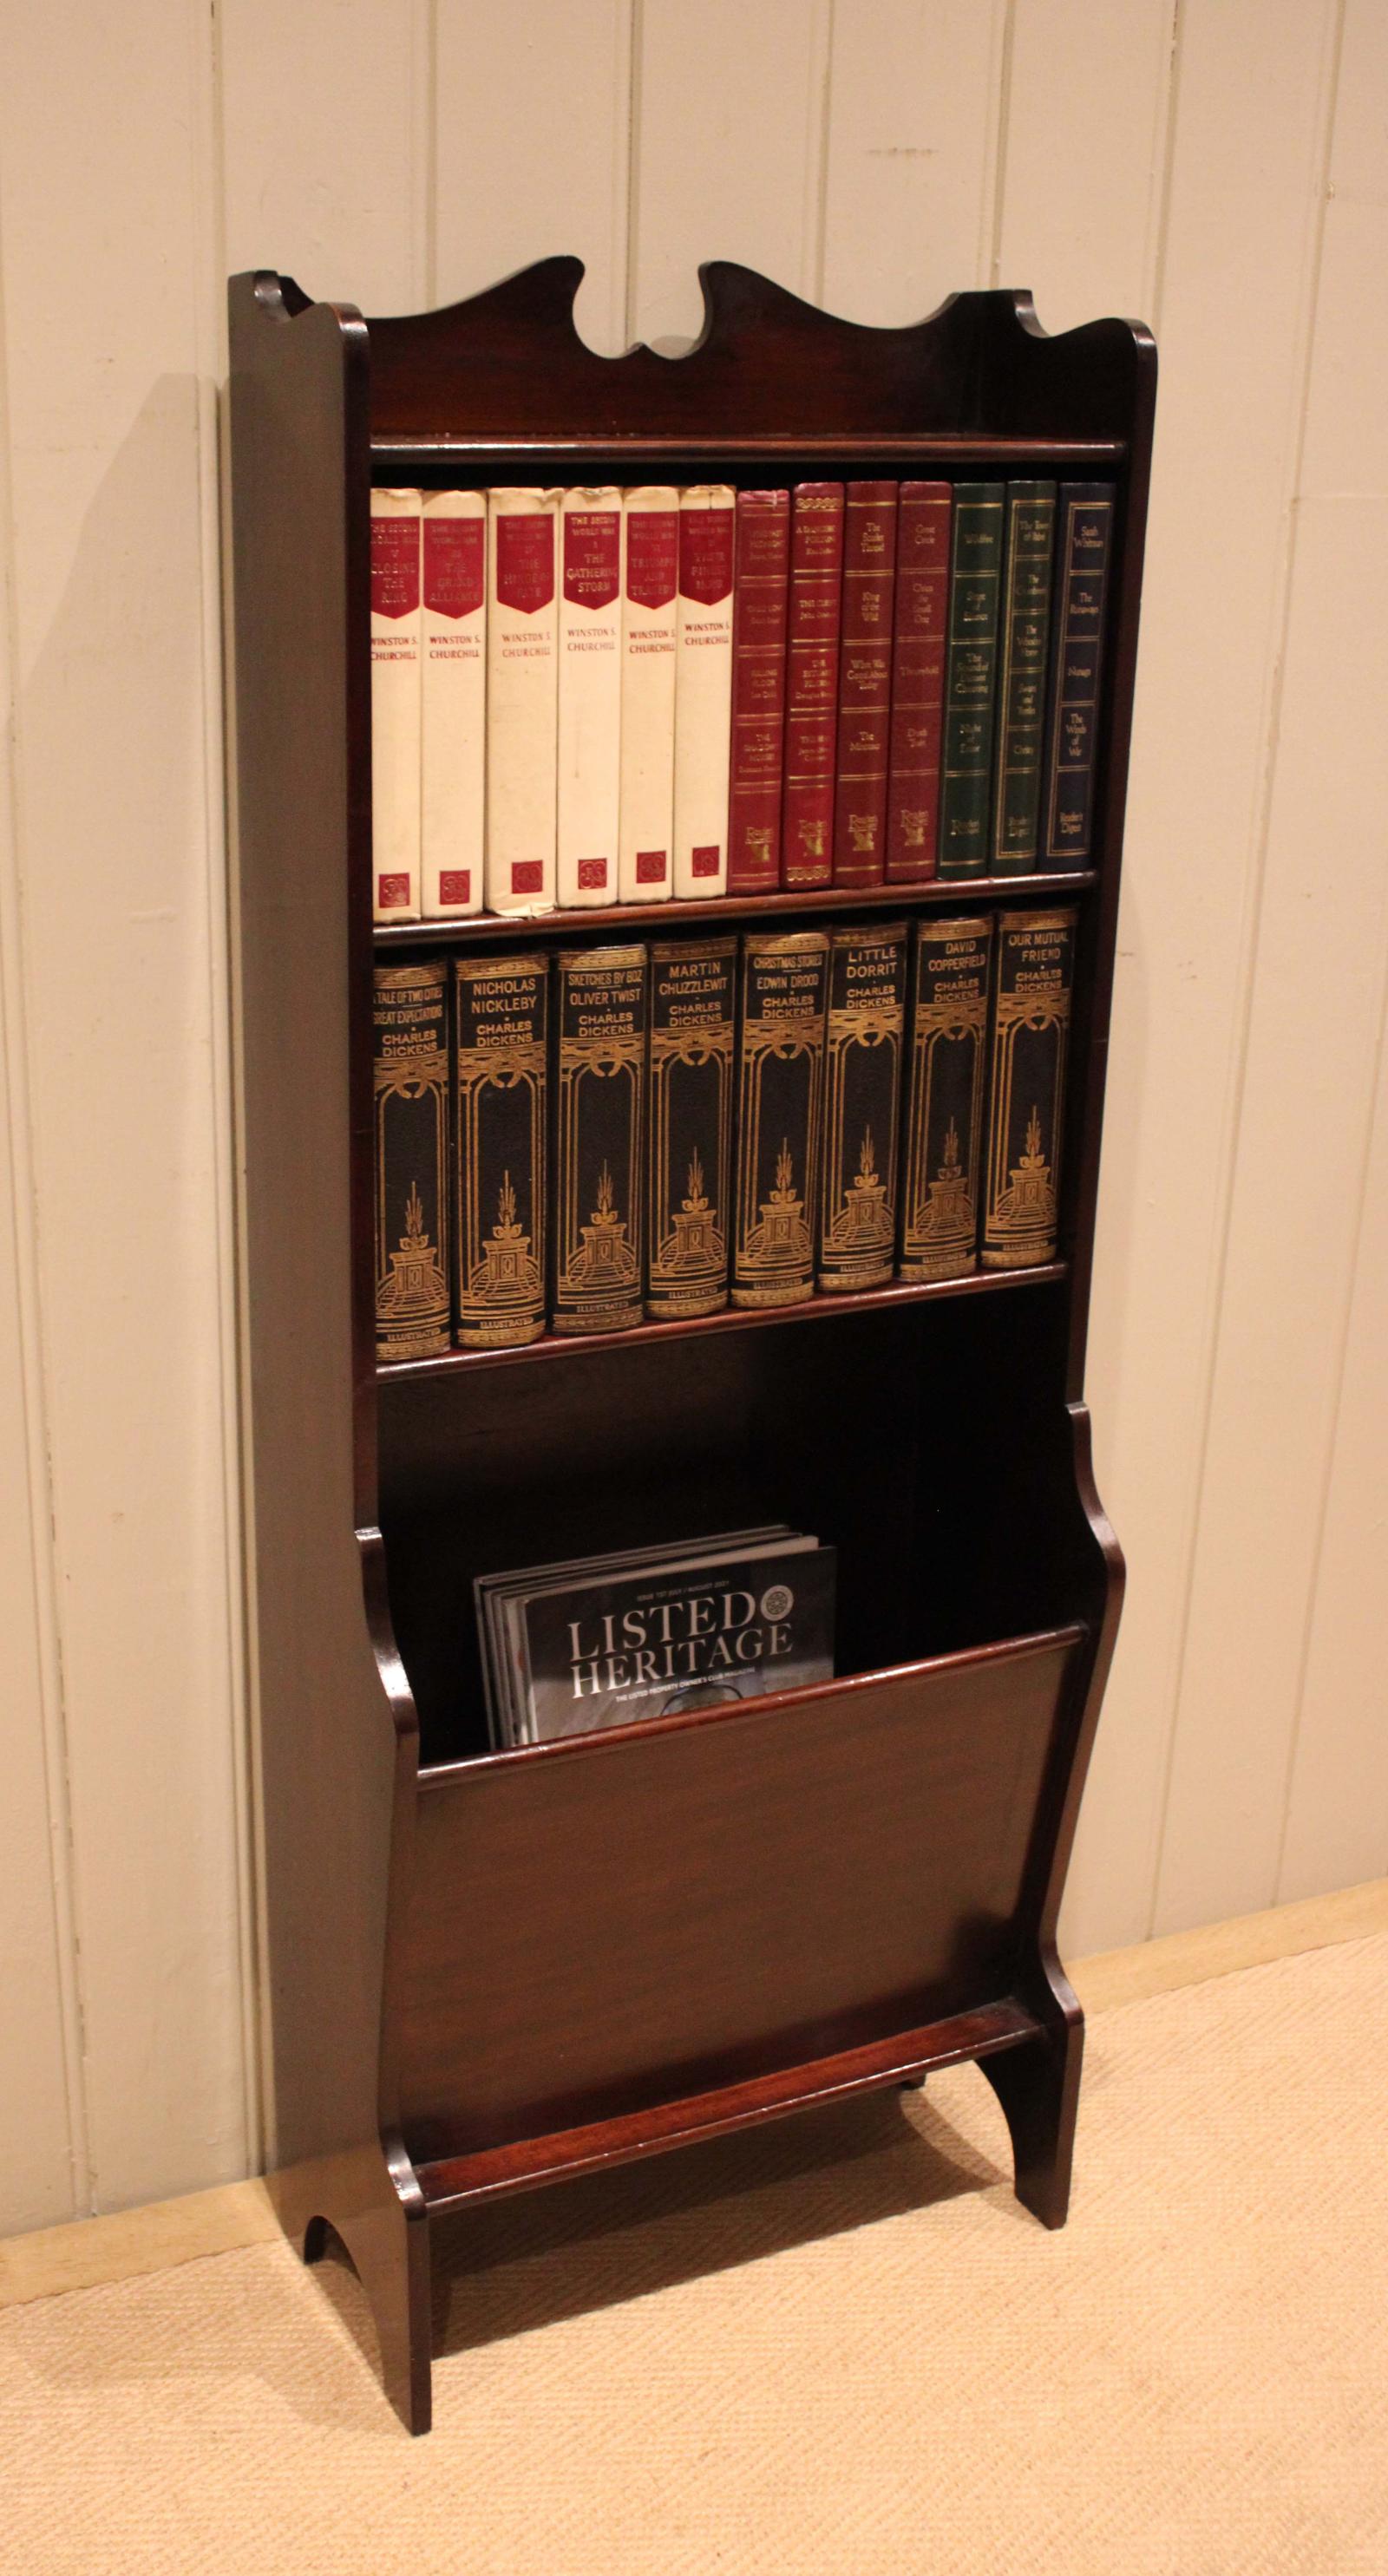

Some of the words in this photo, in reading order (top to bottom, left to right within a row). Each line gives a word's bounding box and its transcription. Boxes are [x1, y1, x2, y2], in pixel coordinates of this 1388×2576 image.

[584, 553, 605, 563] THE
[578, 582, 611, 592] STORM
[567, 629, 608, 637] WINSTON
[685, 623, 723, 631] WINSTON
[429, 636, 471, 644] WINSTON
[502, 633, 542, 642] WINSTON
[685, 637, 729, 645] CHURCHILL
[502, 648, 551, 657] CHURCHILL
[567, 643, 615, 651] CHURCHILL
[429, 650, 479, 659] CHURCHILL
[1009, 934, 1031, 945] OUR
[848, 946, 896, 962] LITTLE
[946, 941, 977, 954] DAVID
[1022, 948, 1061, 962] FRIEND
[754, 956, 796, 970] CHRISTMAS
[928, 954, 985, 971] COPPERFIELD
[670, 962, 721, 978] MARTIN
[847, 962, 898, 978] DORRIT
[1016, 969, 1062, 982] CHARLES
[568, 972, 611, 986] SKETCHES
[613, 971, 625, 984] BY
[626, 970, 642, 983] BOZ
[756, 977, 788, 990] EDWIN
[791, 974, 819, 988] DROOD
[934, 977, 979, 991] CHARLES
[473, 978, 536, 996] NICHOLAS
[659, 977, 728, 996] CHUZZLEWIT
[847, 985, 895, 997] CHARLES
[1015, 980, 1062, 993] DICKENS
[376, 991, 396, 1004] TALE
[570, 992, 608, 1006] OLIVER
[612, 989, 641, 1004] TWIST
[763, 995, 815, 1008] CHARLES
[847, 996, 895, 1009] DICKENS
[934, 990, 979, 1003] DICKENS
[471, 996, 537, 1014] NICKLEBY
[669, 1002, 721, 1015] CHARLES
[579, 1012, 633, 1025] CHARLES
[763, 1007, 815, 1019] DICKENS
[669, 1013, 722, 1027] DICKENS
[477, 1021, 533, 1035] CHARLES
[579, 1024, 634, 1036] DICKENS
[382, 1030, 436, 1045] CHARLES
[477, 1033, 534, 1047] DICKENS
[382, 1042, 437, 1057] DICKENS
[480, 1317, 534, 1330] ILLUSTRATED
[387, 1327, 441, 1342] ILLUSTRATED
[567, 1591, 756, 1662] LISTED
[570, 1623, 795, 1699] HERITAGE
[616, 1694, 627, 1703] THE
[628, 1690, 648, 1701] LISTED
[649, 1683, 678, 1694] PROPERTY
[708, 1673, 723, 1682] CLUB
